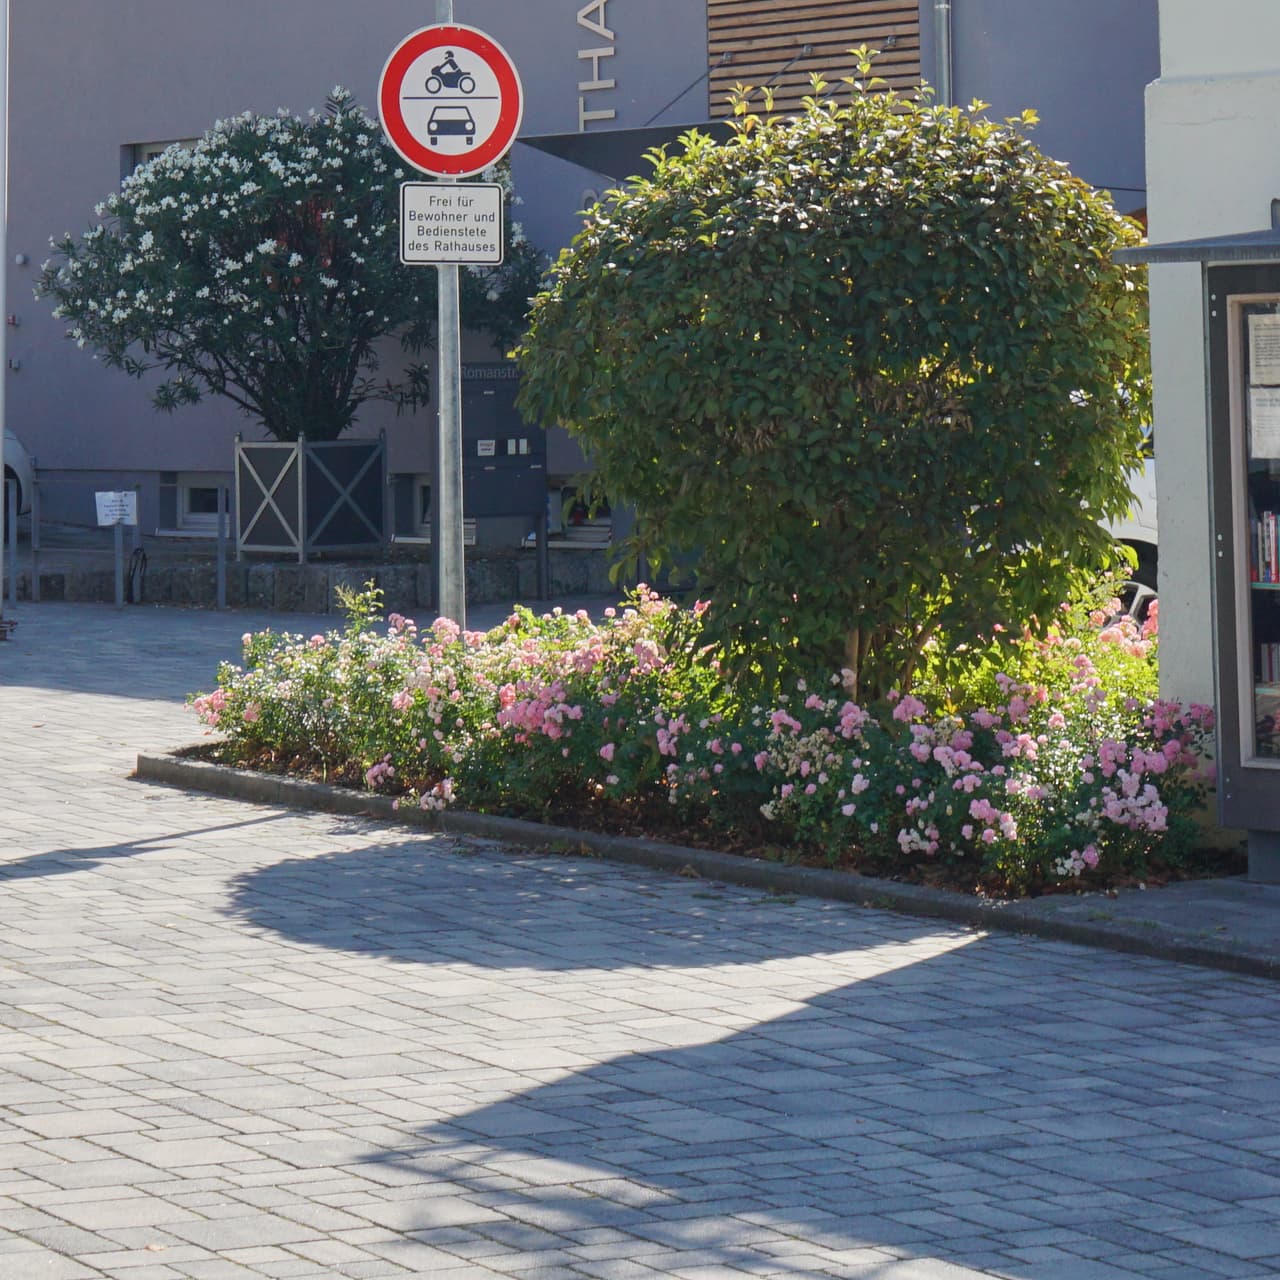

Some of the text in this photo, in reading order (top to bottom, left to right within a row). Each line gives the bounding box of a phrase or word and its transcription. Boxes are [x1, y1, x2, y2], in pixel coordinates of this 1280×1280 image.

[429, 195, 474, 207] Frei für
[408, 210, 495, 222] Bewohner und
[417, 225, 487, 237] Bedienstete
[408, 240, 496, 252] des Rathauses
